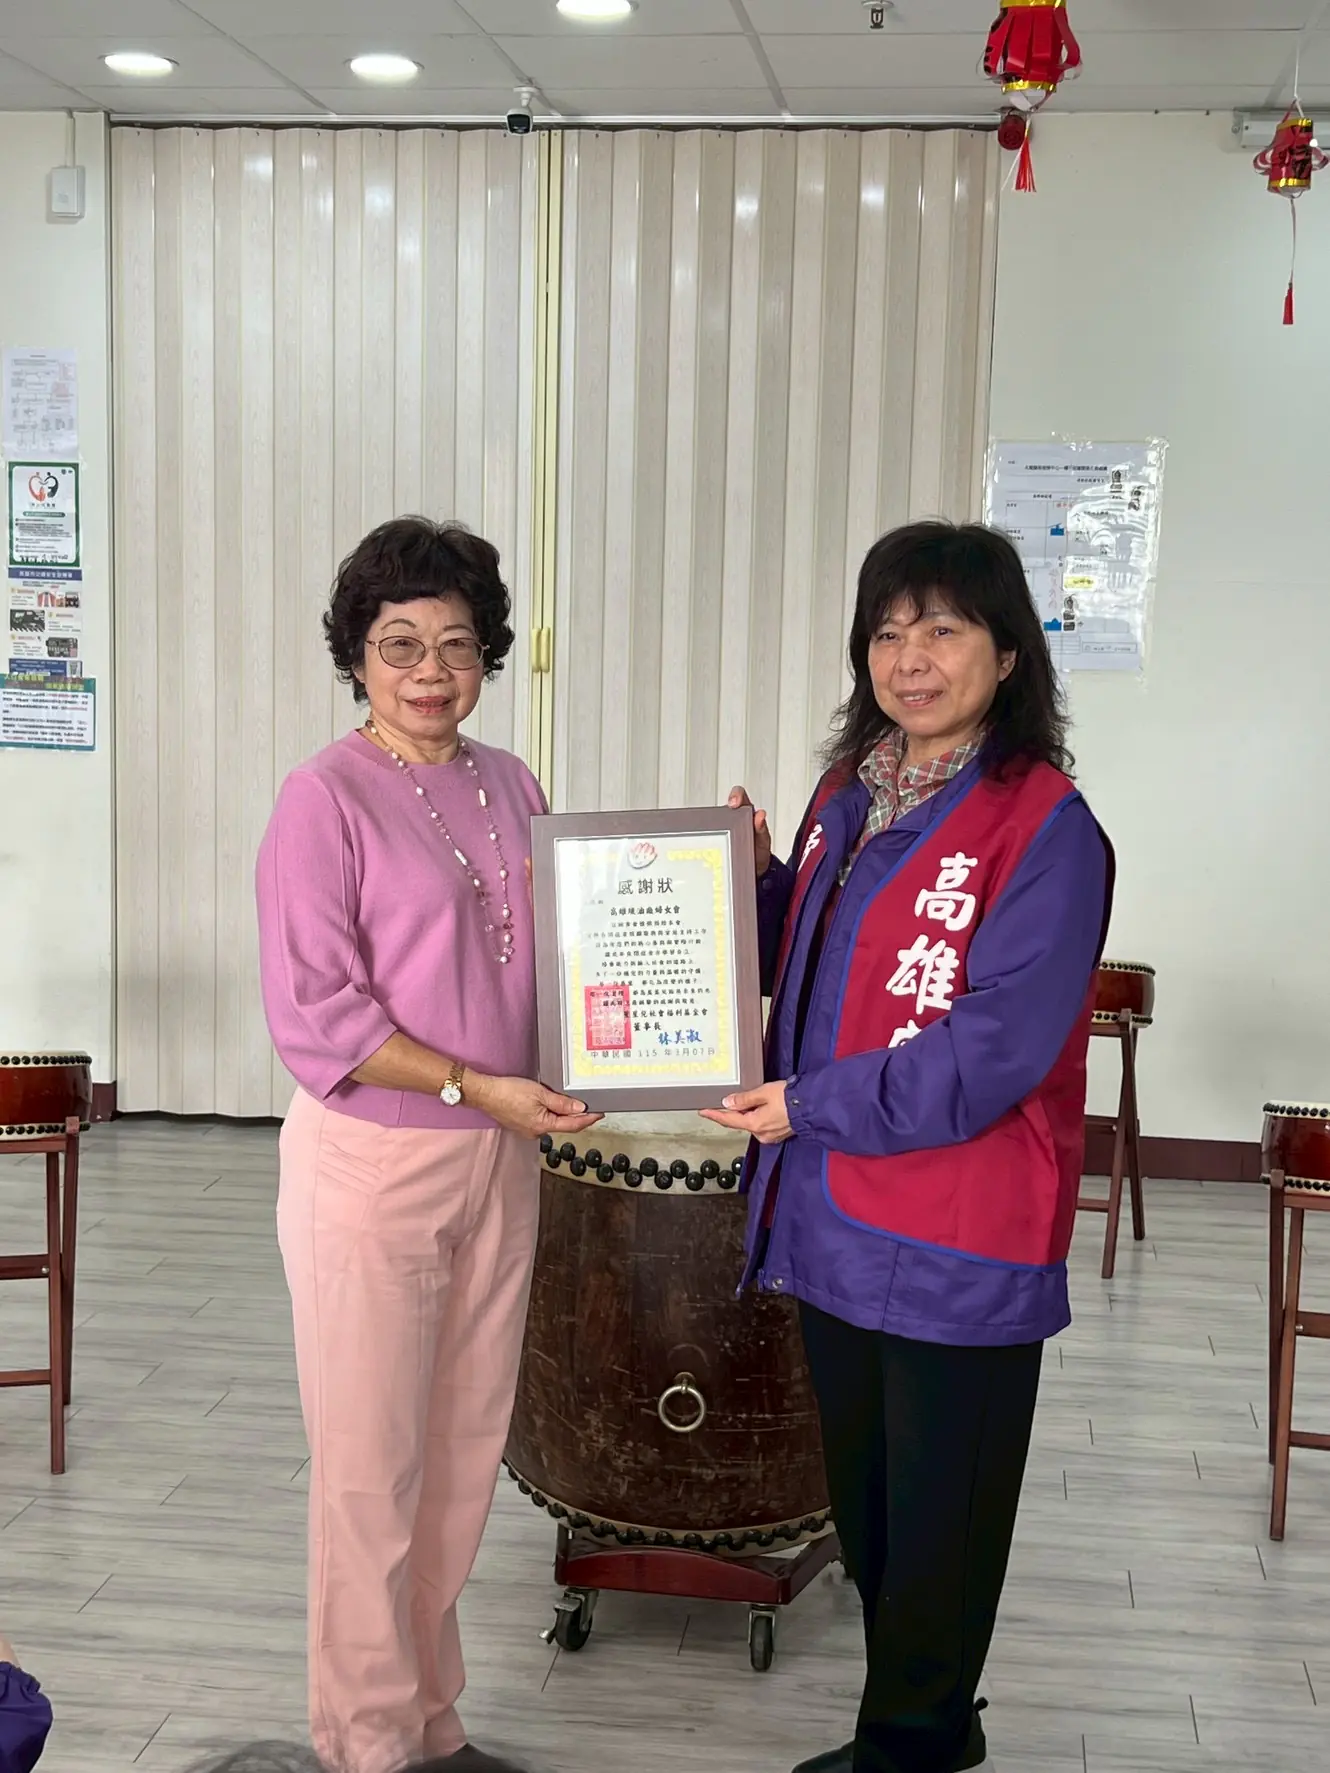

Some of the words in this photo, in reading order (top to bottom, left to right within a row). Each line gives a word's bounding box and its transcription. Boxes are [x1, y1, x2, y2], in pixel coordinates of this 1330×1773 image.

[618, 877, 673, 895] 感謝狀
[633, 1022, 662, 1031] 董事長
[590, 1050, 632, 1059] 中華民國
[638, 1049, 658, 1058] 115
